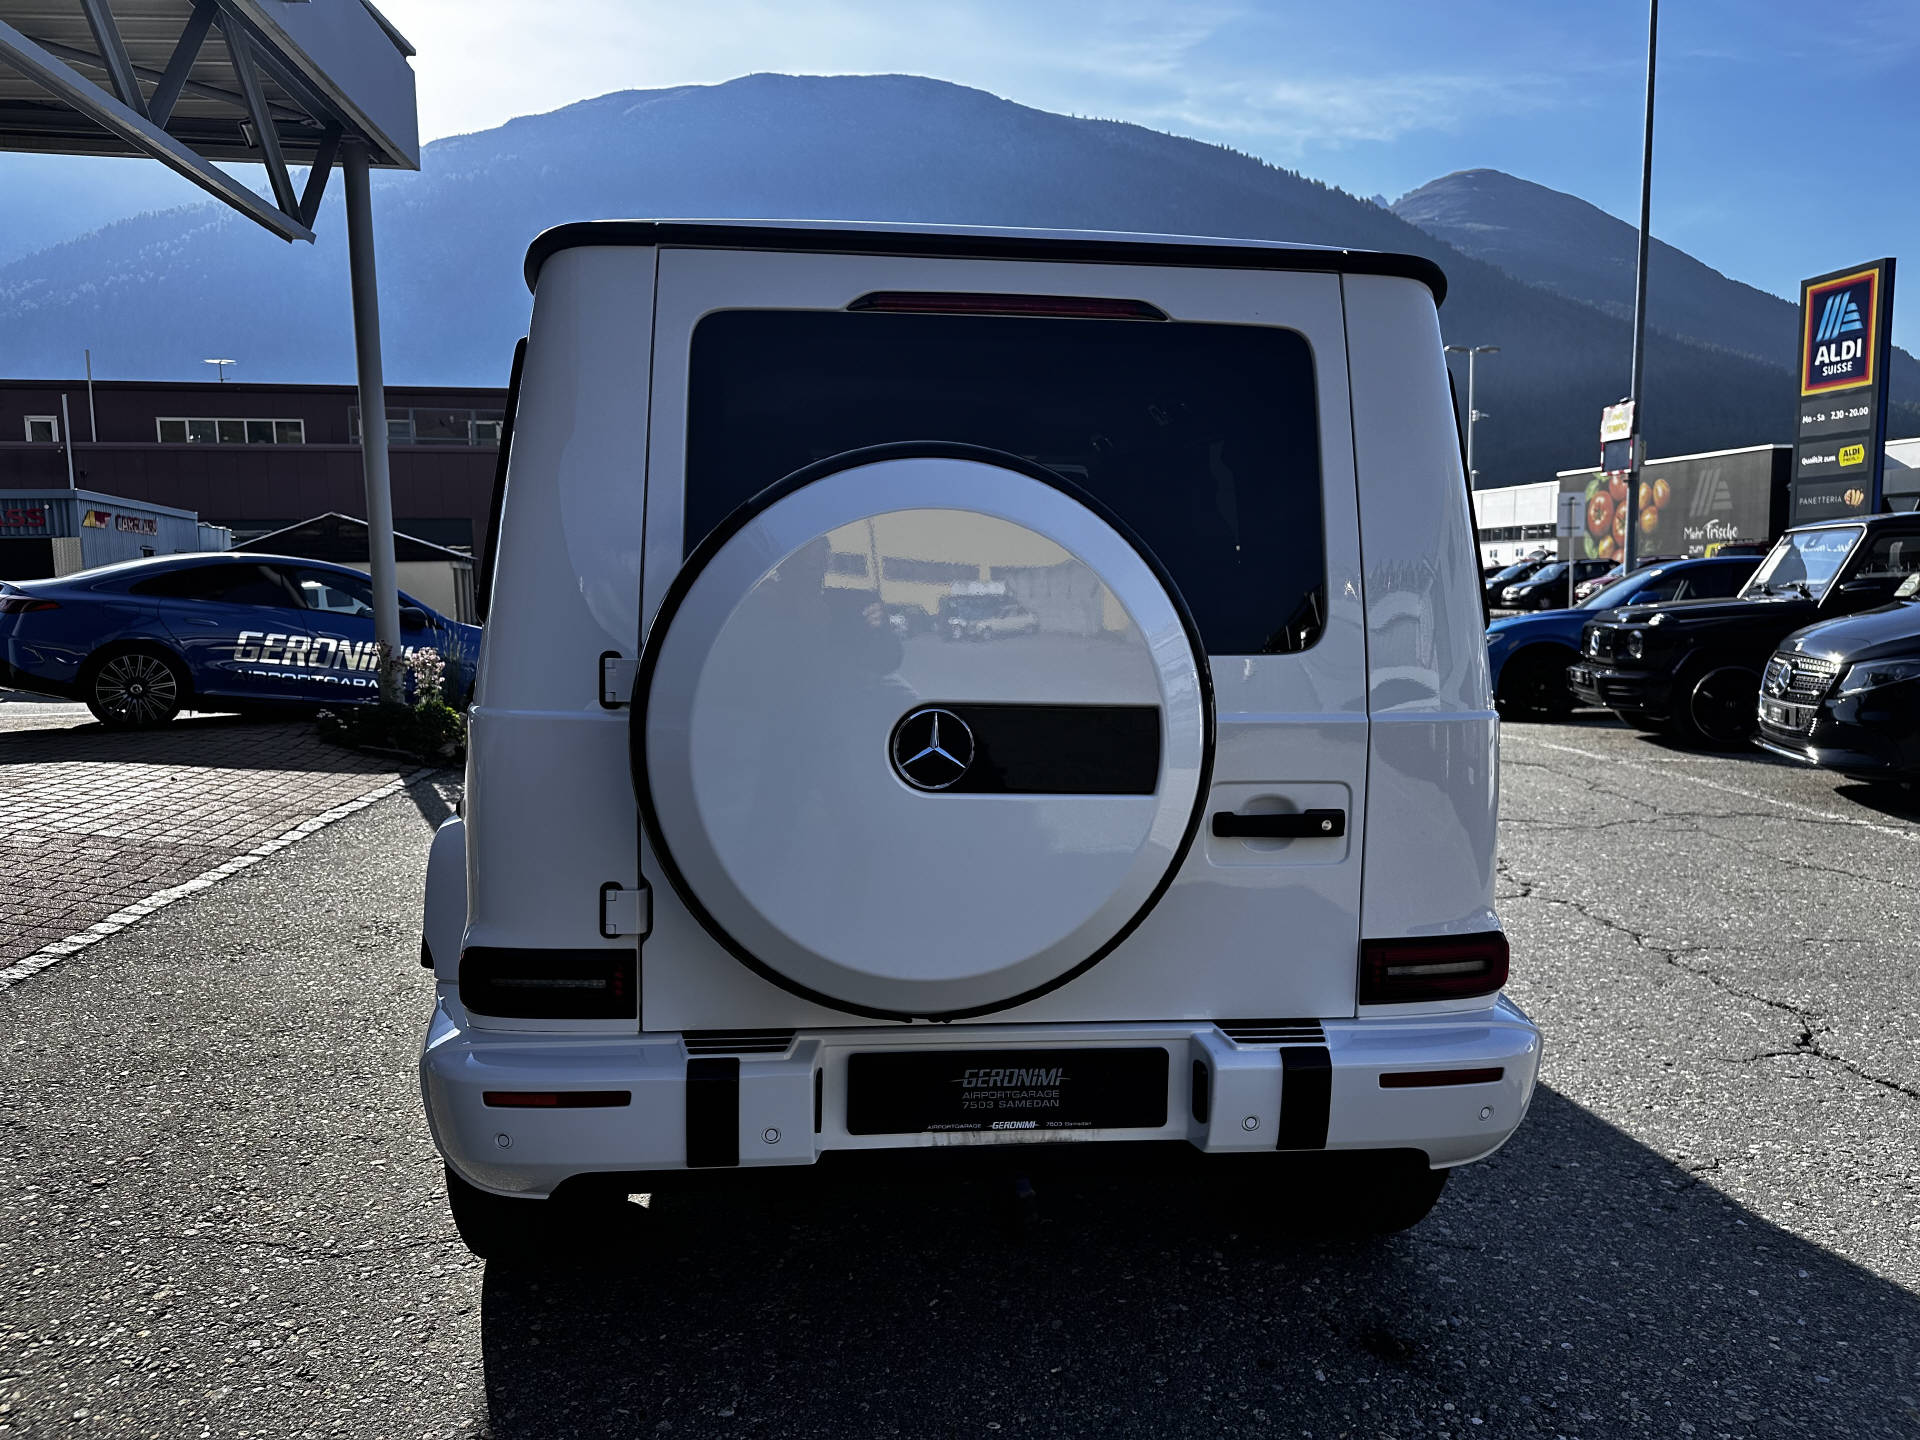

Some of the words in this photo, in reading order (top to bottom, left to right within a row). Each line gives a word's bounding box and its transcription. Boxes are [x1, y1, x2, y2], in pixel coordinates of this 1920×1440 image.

[1814, 337, 1862, 366] ALDI
[1822, 361, 1853, 376] SUISSE
[1843, 447, 1860, 457] ALDI
[1799, 495, 1842, 505] PANETTERIA
[233, 630, 414, 672] GERONI
[962, 1068, 1063, 1088] GERONIMI
[962, 1089, 1060, 1100] AIRPORTGARAGE
[962, 1101, 994, 1109] 7503
[998, 1099, 1060, 1109] SAMEDAN
[991, 1120, 1036, 1130] GERONIMI
